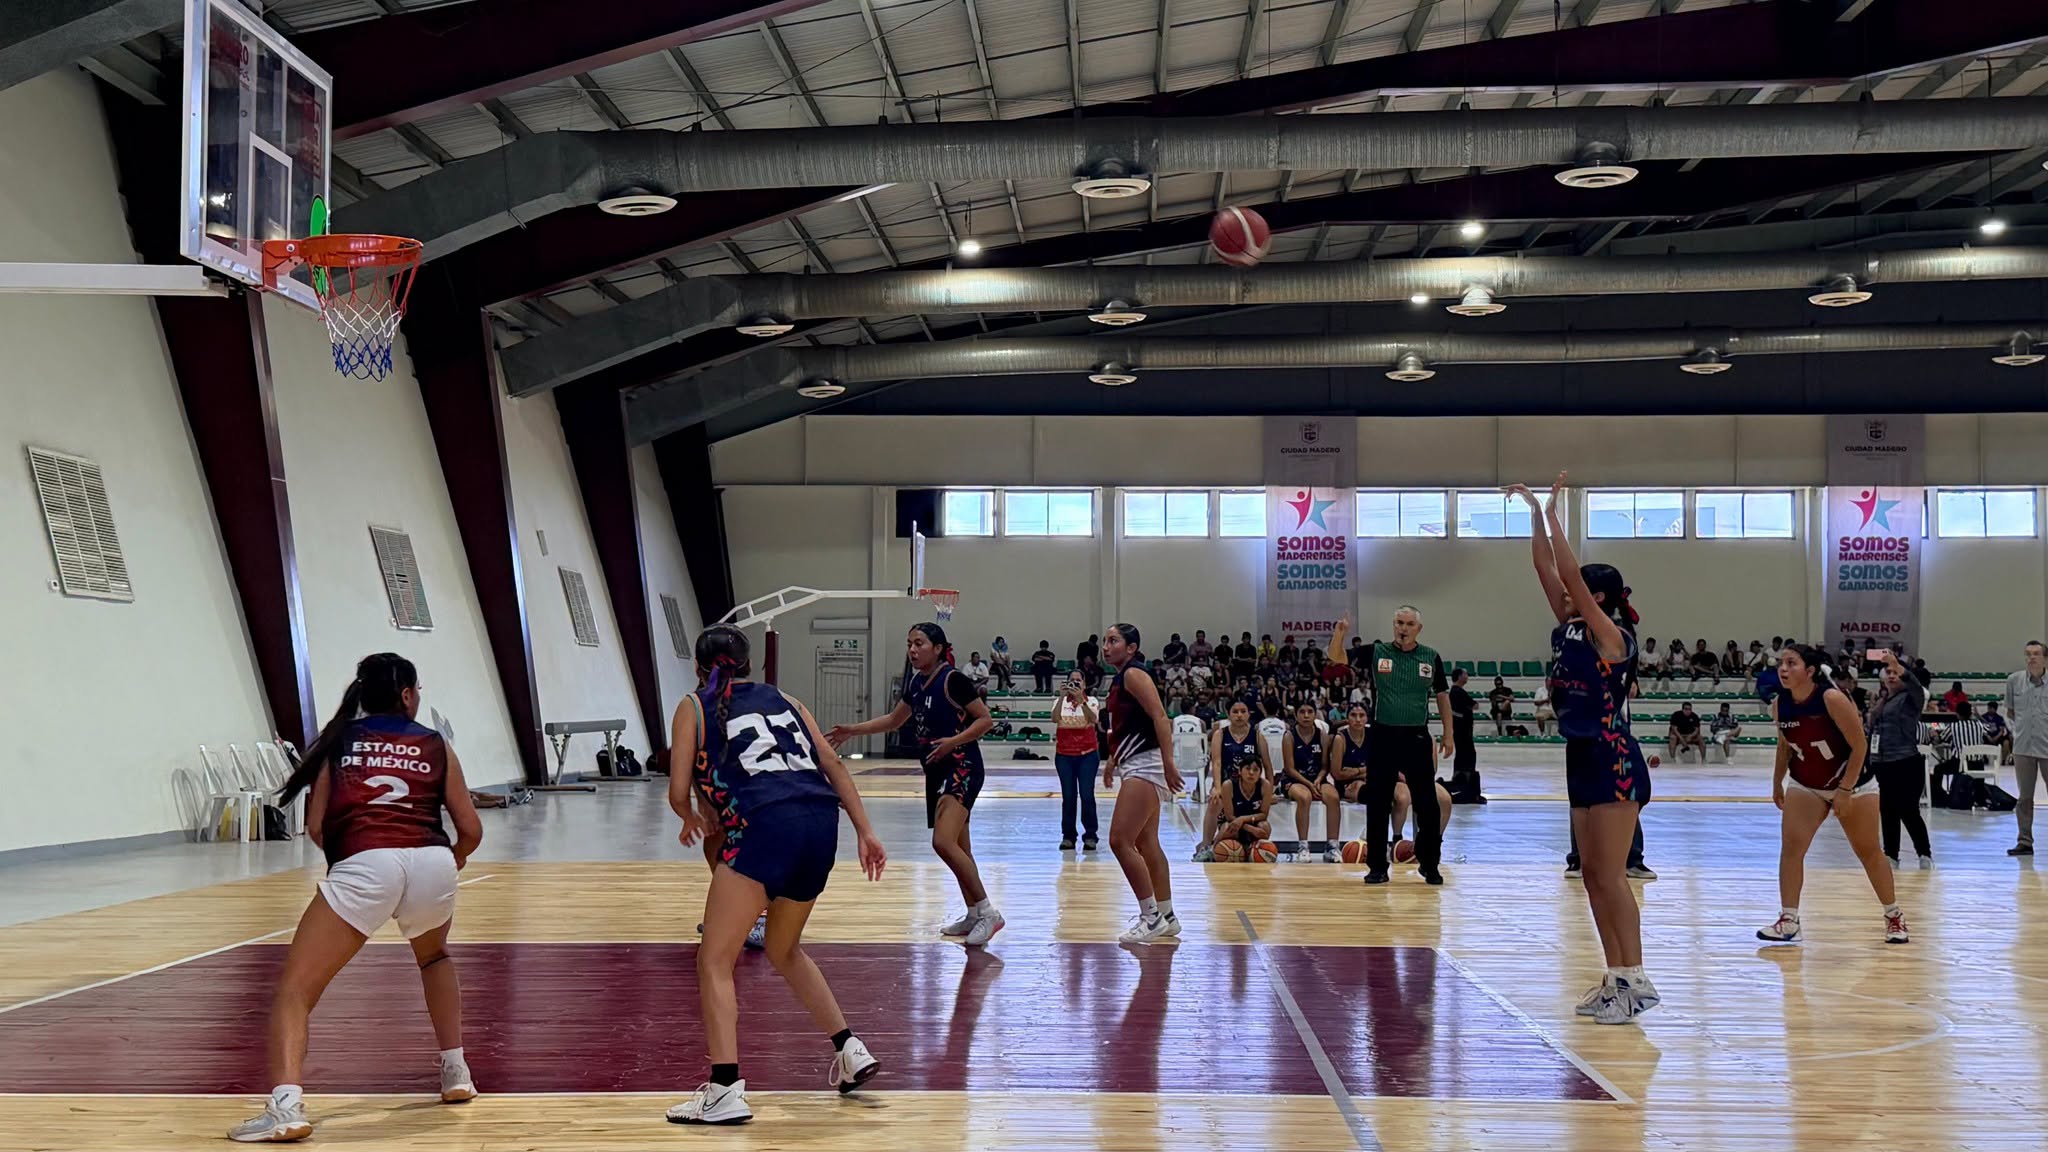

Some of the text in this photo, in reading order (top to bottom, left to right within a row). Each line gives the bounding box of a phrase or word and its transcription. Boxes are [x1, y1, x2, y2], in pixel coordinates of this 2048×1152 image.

[1277, 535, 1346, 552] SOMOS
[1839, 536, 1910, 552] SOMOS
[1277, 563, 1346, 579] SOMOS
[1839, 564, 1909, 580] SOMOS
[1277, 579, 1347, 591] GANADORES
[1838, 580, 1909, 592] GANADORES
[1840, 622, 1901, 633] MADERO
[924, 695, 932, 709] 4
[352, 741, 421, 756] ESTADO
[726, 709, 817, 777] 23
[1244, 744, 1255, 754] 24
[340, 755, 431, 774] DE MÉXICO
[362, 775, 414, 808] 2
